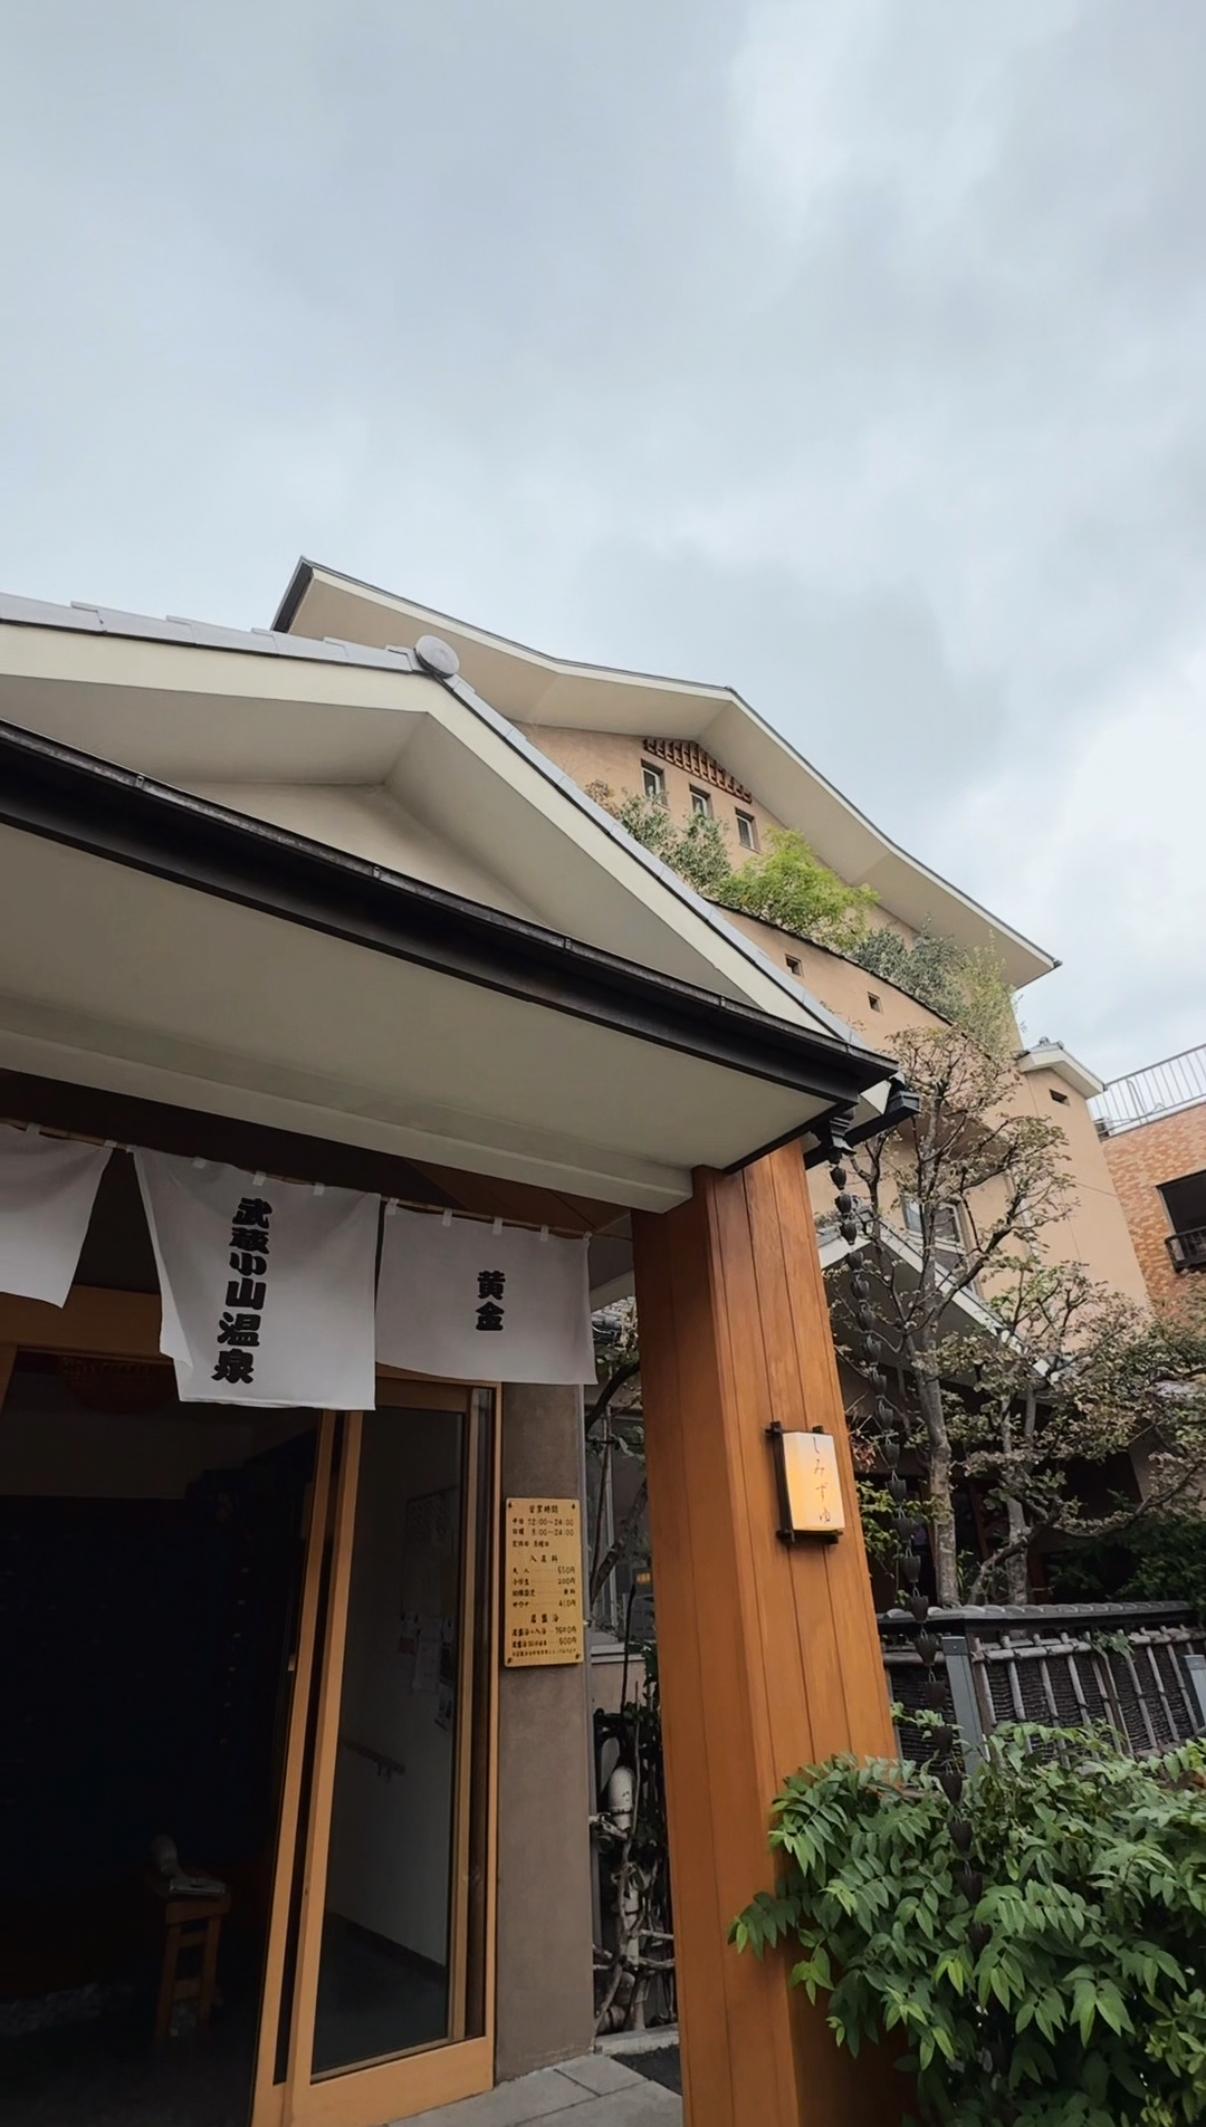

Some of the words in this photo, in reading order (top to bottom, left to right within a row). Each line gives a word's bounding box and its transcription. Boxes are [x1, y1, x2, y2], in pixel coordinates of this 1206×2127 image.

[211, 1197, 273, 1384] 武蔵小山温泉
[475, 1270, 506, 1331] 黄金
[812, 1436, 831, 1523] しみずゆ
